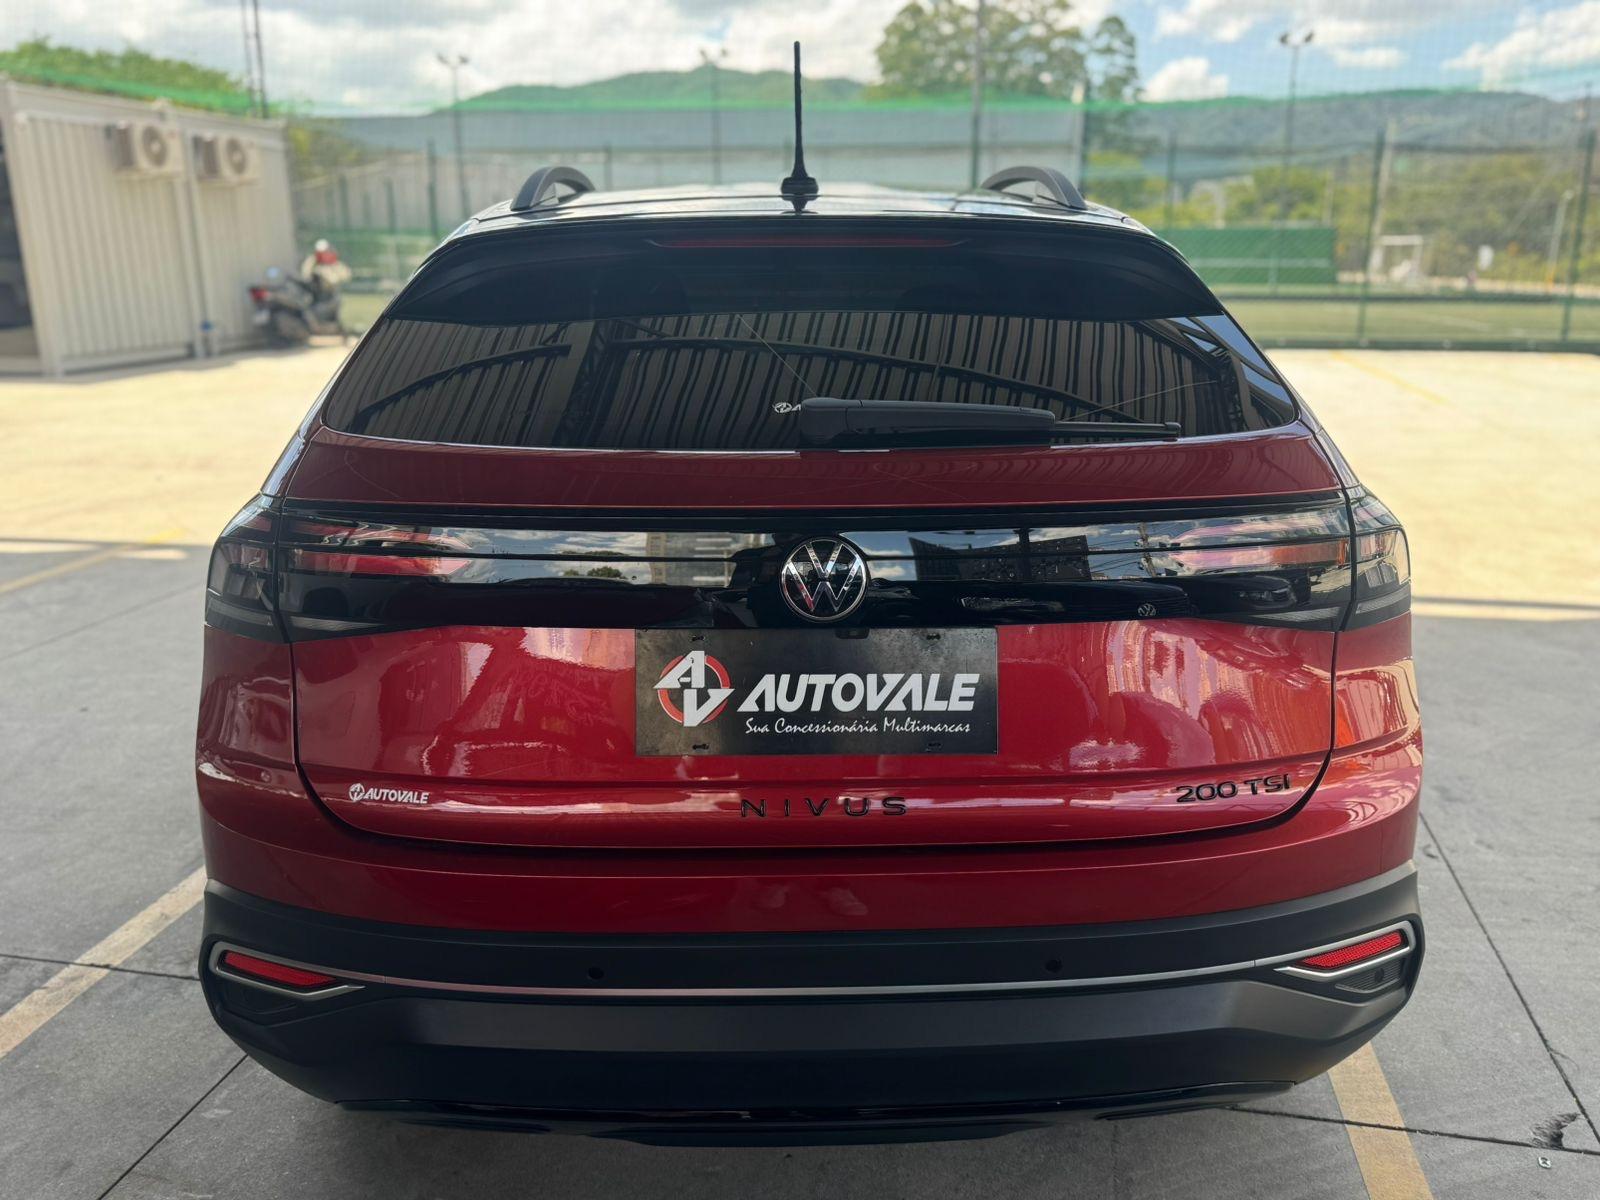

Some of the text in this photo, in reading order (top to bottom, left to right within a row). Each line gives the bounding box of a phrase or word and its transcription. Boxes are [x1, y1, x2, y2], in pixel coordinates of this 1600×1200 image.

[737, 673, 980, 713] AUTOVALE
[745, 716, 971, 735] Sua Concessionária Multimarcas
[363, 787, 430, 804] AUTOVALE
[1176, 773, 1290, 803] 200 TSI
[740, 796, 907, 817] NIVUS
